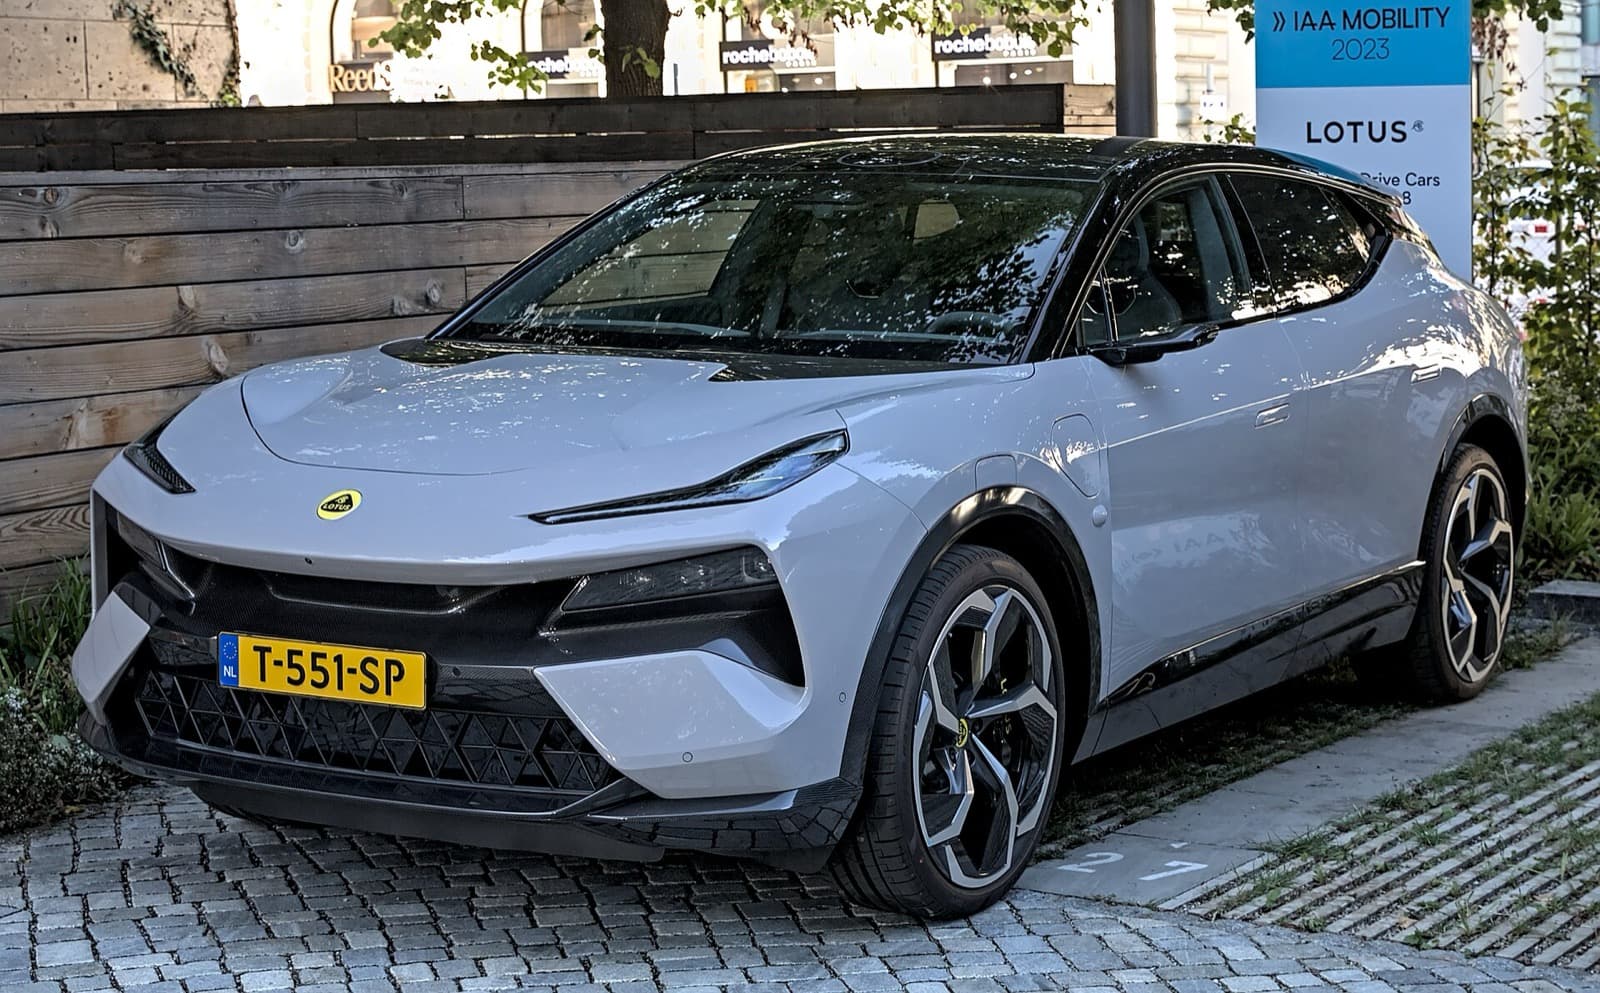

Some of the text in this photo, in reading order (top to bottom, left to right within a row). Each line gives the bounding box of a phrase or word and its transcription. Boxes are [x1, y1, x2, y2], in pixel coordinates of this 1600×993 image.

[1293, 7, 1451, 32] IAA MOBILITY
[1331, 37, 1390, 61] 2023
[1306, 120, 1407, 144] LOTUS
[1360, 172, 1441, 187] ive Cars
[322, 502, 351, 511] LOTUS
[223, 665, 237, 678] NL
[253, 645, 405, 696] T-551-SP
